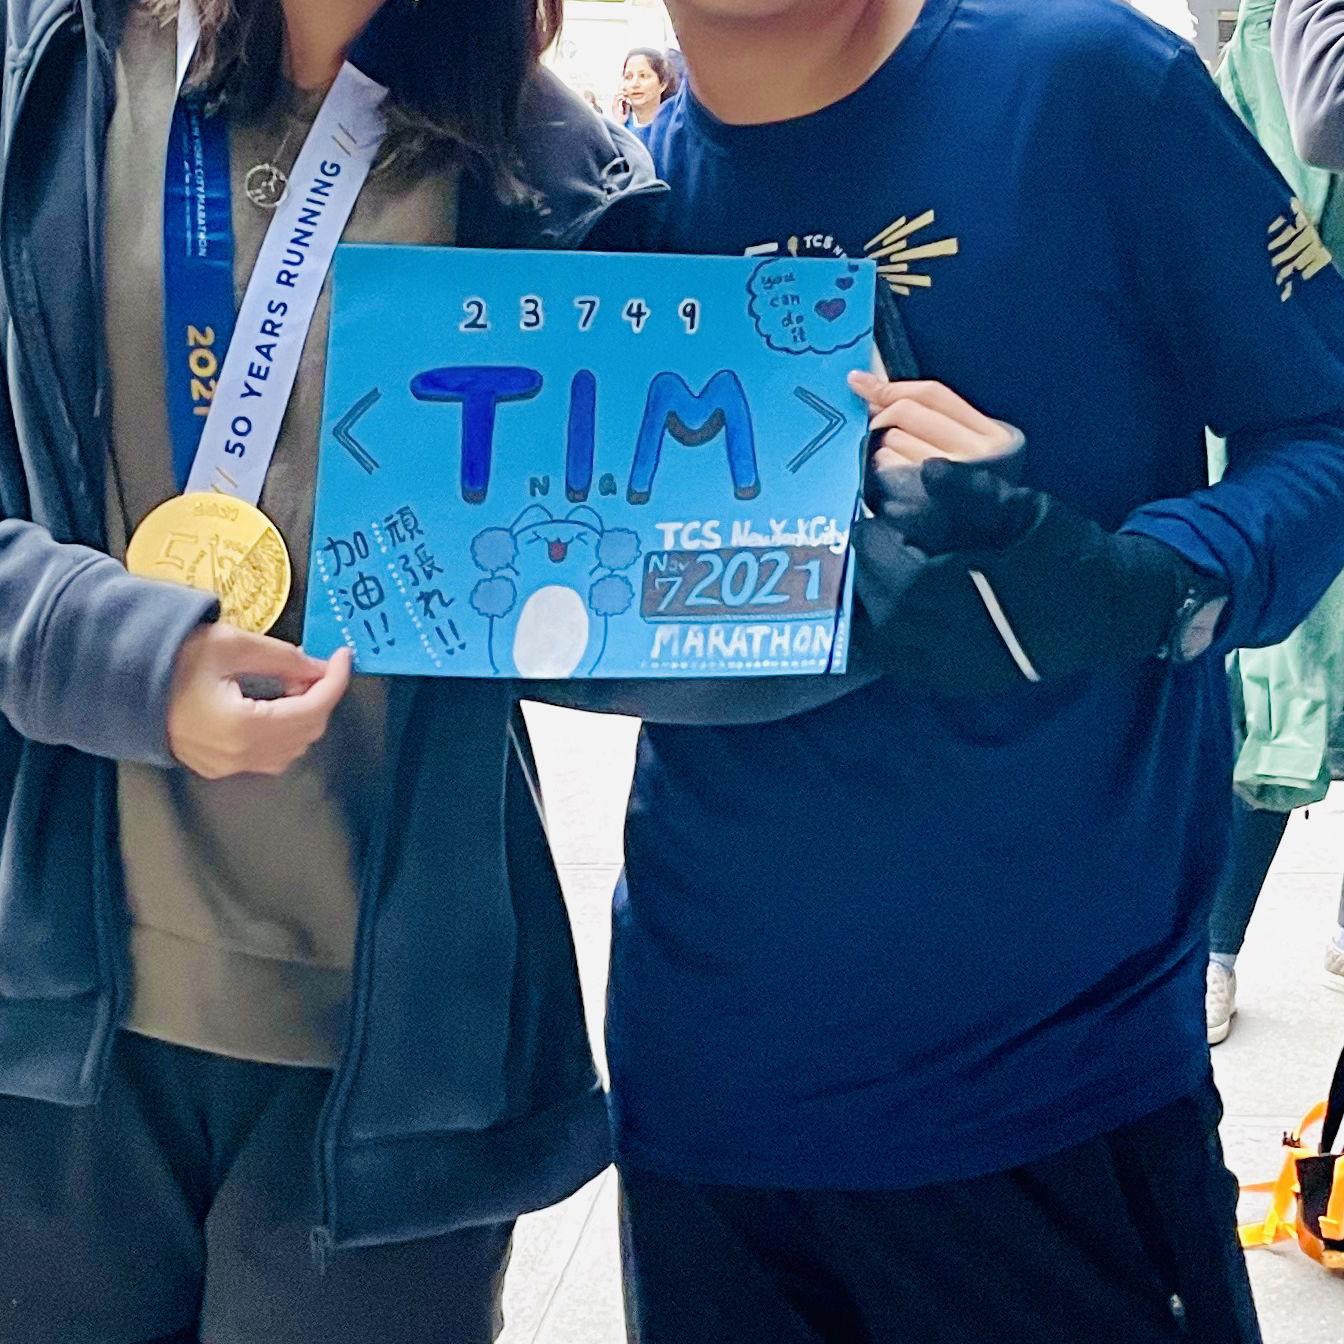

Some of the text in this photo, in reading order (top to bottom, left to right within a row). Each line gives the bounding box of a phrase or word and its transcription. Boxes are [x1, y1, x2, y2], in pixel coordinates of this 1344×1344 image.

[803, 234, 834, 250] TCS
[225, 159, 342, 458] 50 YEARS RUNNING
[769, 291, 801, 308] can
[187, 324, 218, 416] 2021
[410, 365, 762, 505] TIM
[655, 519, 722, 550] TCS
[654, 550, 821, 612] 7 2021
[651, 623, 833, 658] MARATHON
